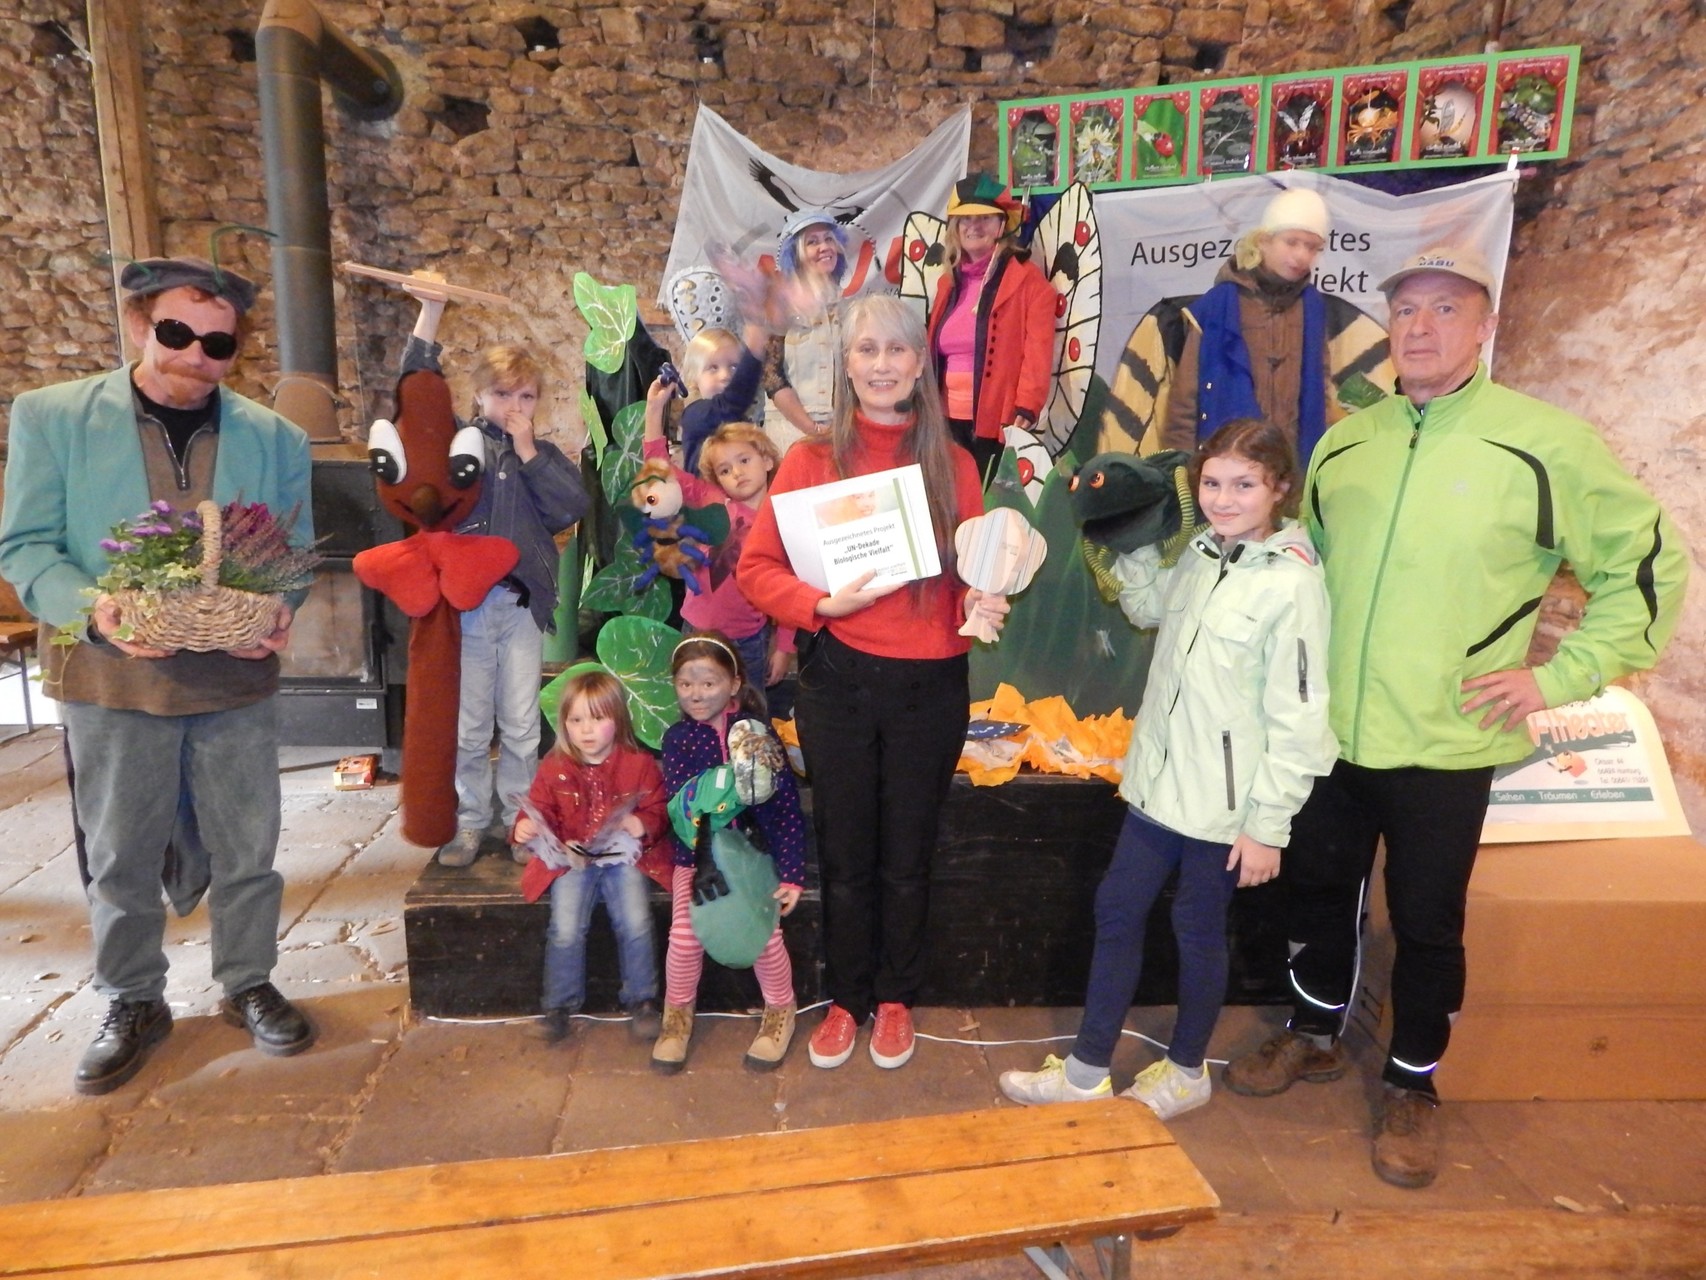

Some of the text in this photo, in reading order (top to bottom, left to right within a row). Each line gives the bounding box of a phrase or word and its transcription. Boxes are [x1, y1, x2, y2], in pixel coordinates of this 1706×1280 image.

[1130, 228, 1371, 268] Ausgeztes
[1313, 266, 1369, 293] jekt
[823, 523, 895, 546] Ausgezeichnetes Projekt
[833, 552, 867, 565] Biologische
[1494, 791, 1525, 802] Sehen
[1590, 789, 1625, 800] Erleben
